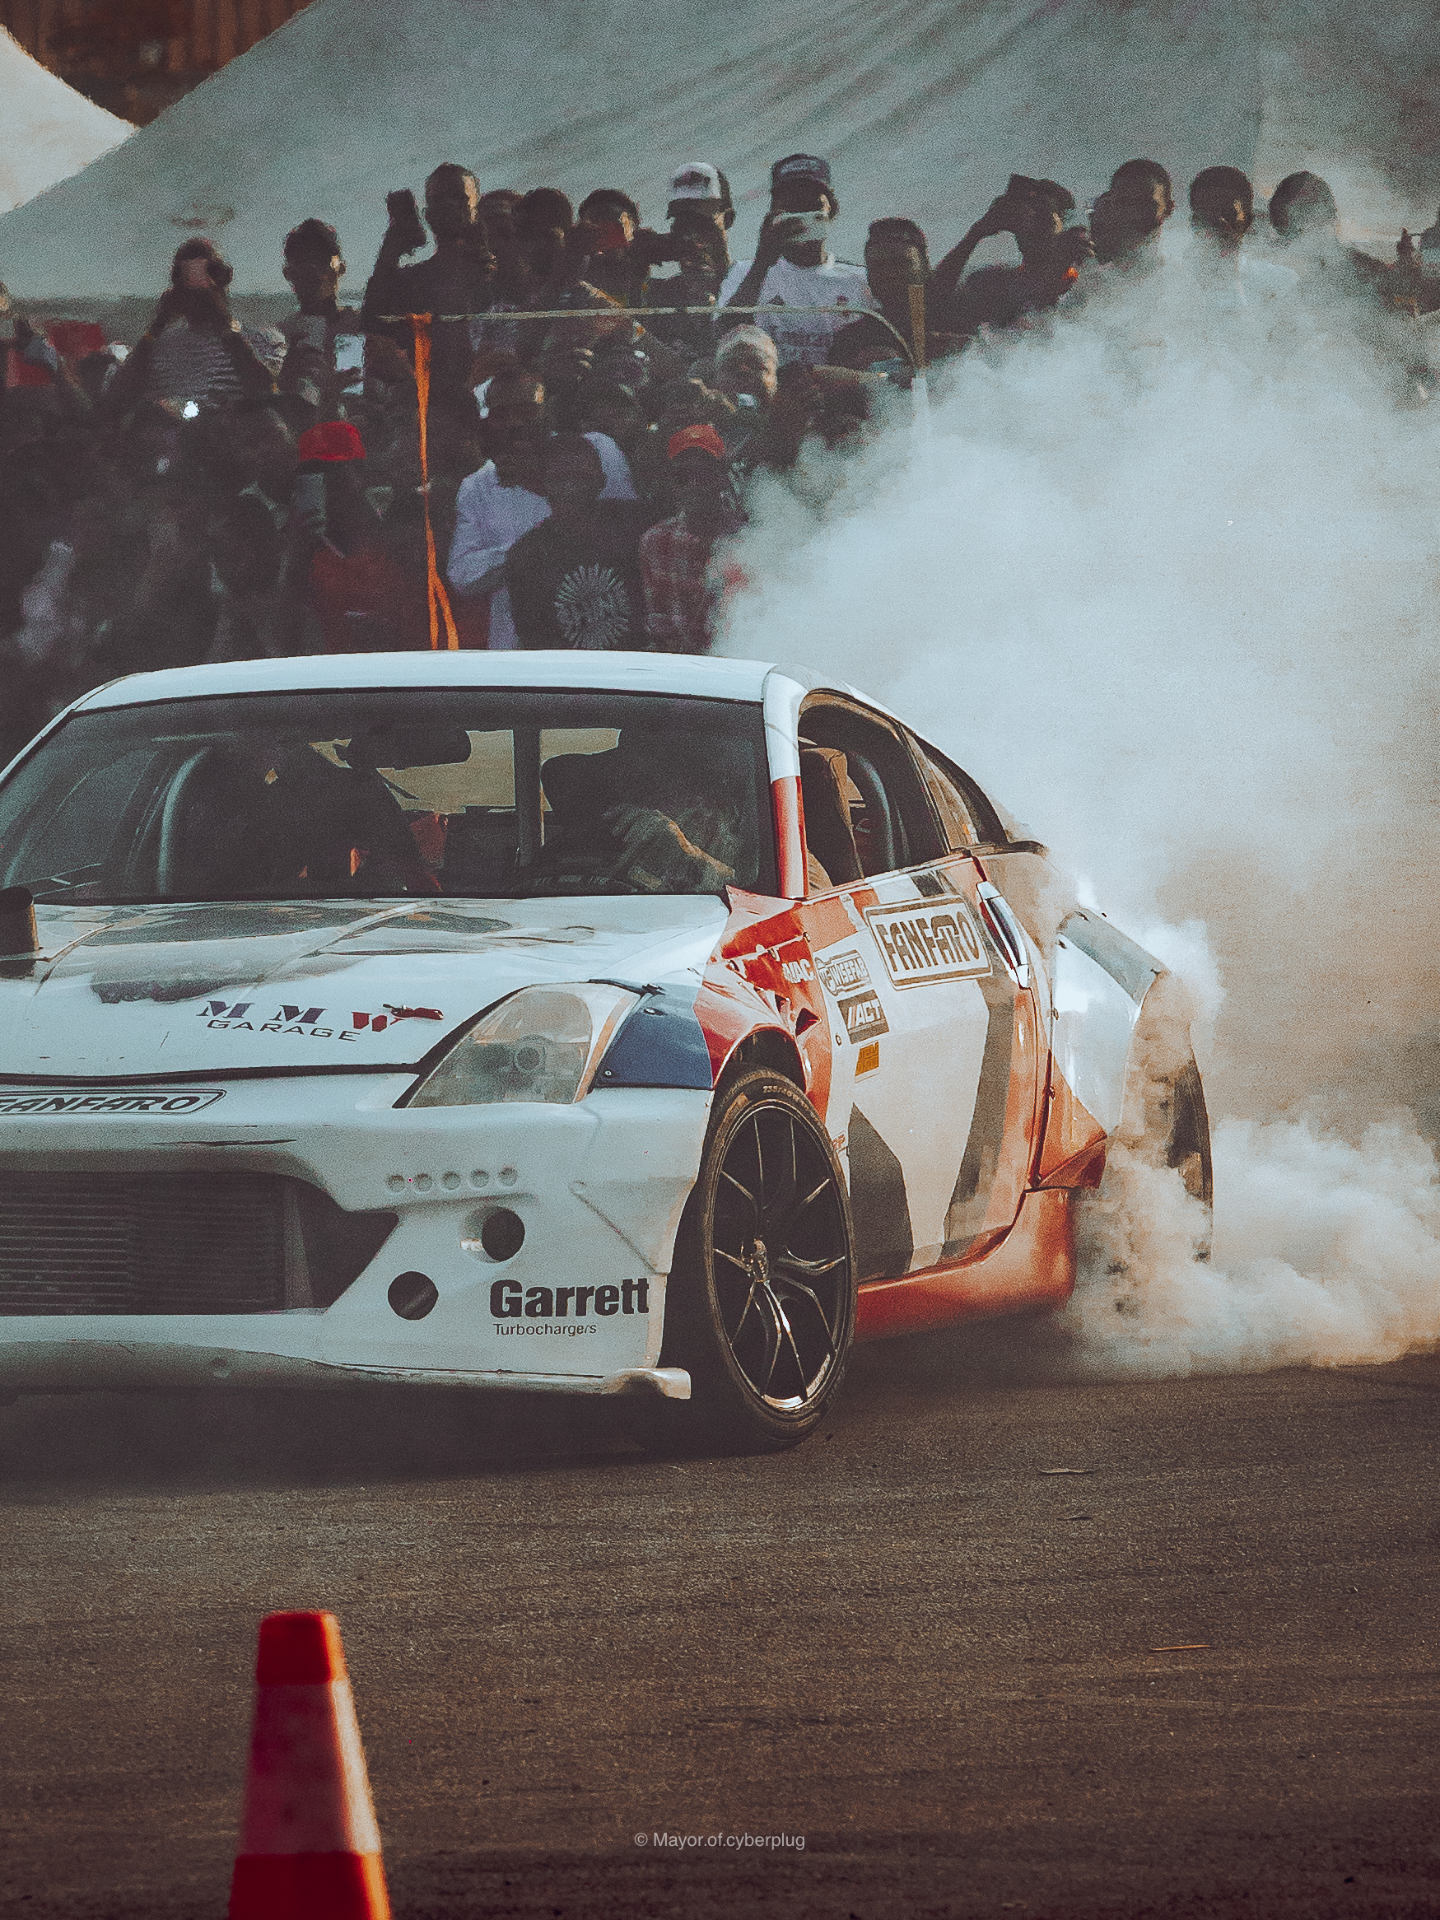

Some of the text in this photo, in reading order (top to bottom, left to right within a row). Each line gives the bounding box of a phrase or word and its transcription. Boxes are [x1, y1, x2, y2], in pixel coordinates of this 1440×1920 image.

[875, 911, 979, 972] FANFARO
[207, 1019, 361, 1041] GARAGE
[490, 1278, 649, 1318] Garrett
[493, 1324, 597, 1337] Turbochargers
